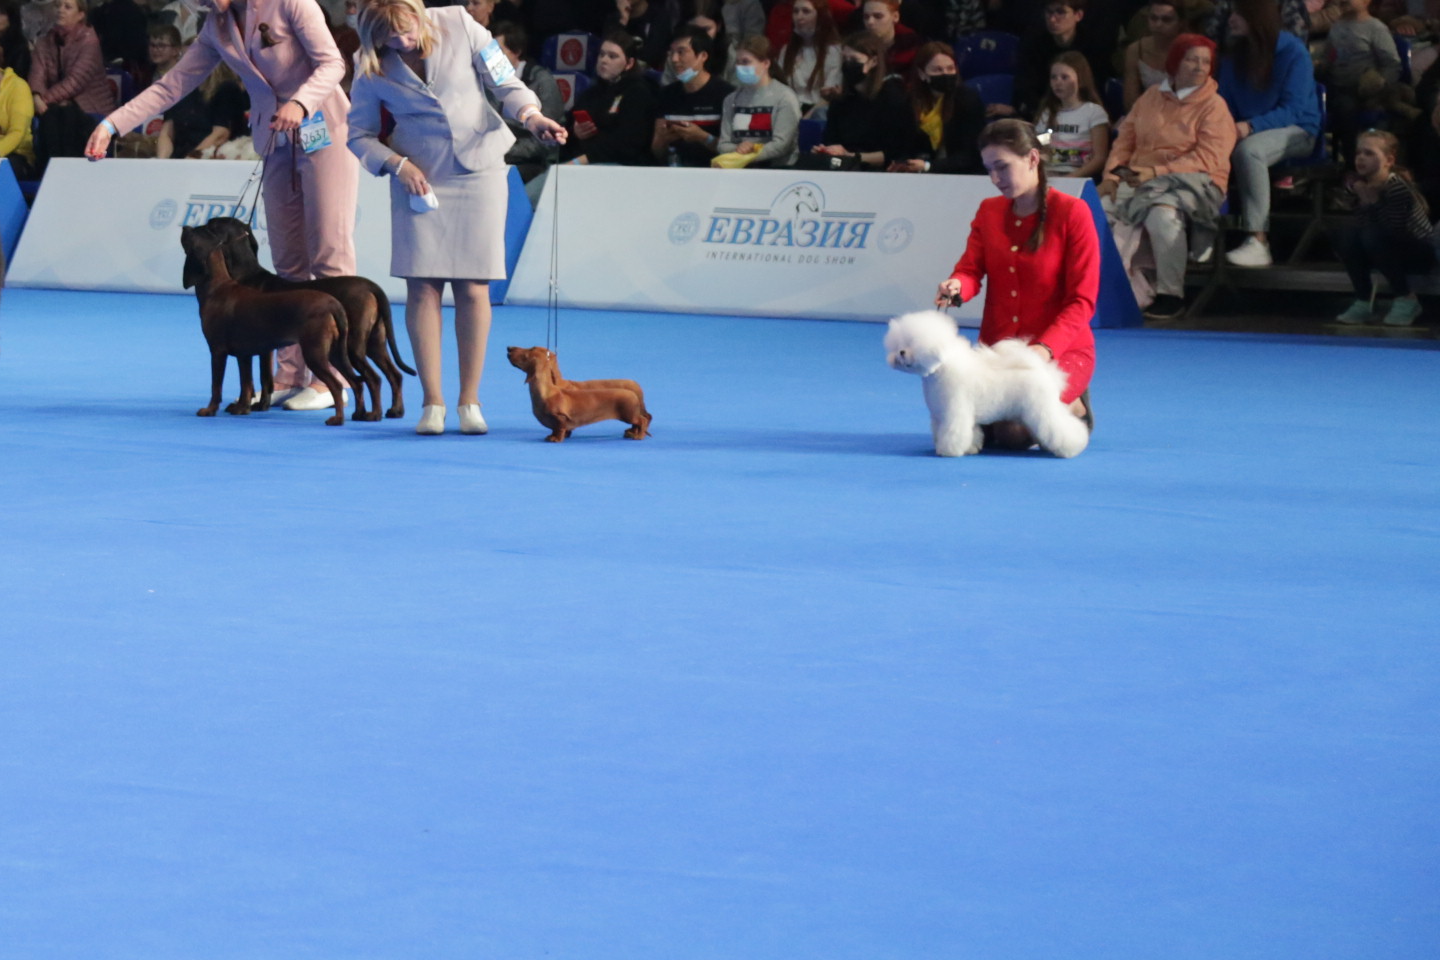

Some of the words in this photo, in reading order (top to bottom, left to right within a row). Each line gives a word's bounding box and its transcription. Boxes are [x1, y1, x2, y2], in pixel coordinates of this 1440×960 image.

[303, 128, 326, 145] 2637
[702, 215, 874, 250] ЕВРАЗИЯ
[706, 251, 792, 264] INTERNATIONAL
[797, 254, 820, 265] DOG
[825, 255, 857, 266] SHOW
